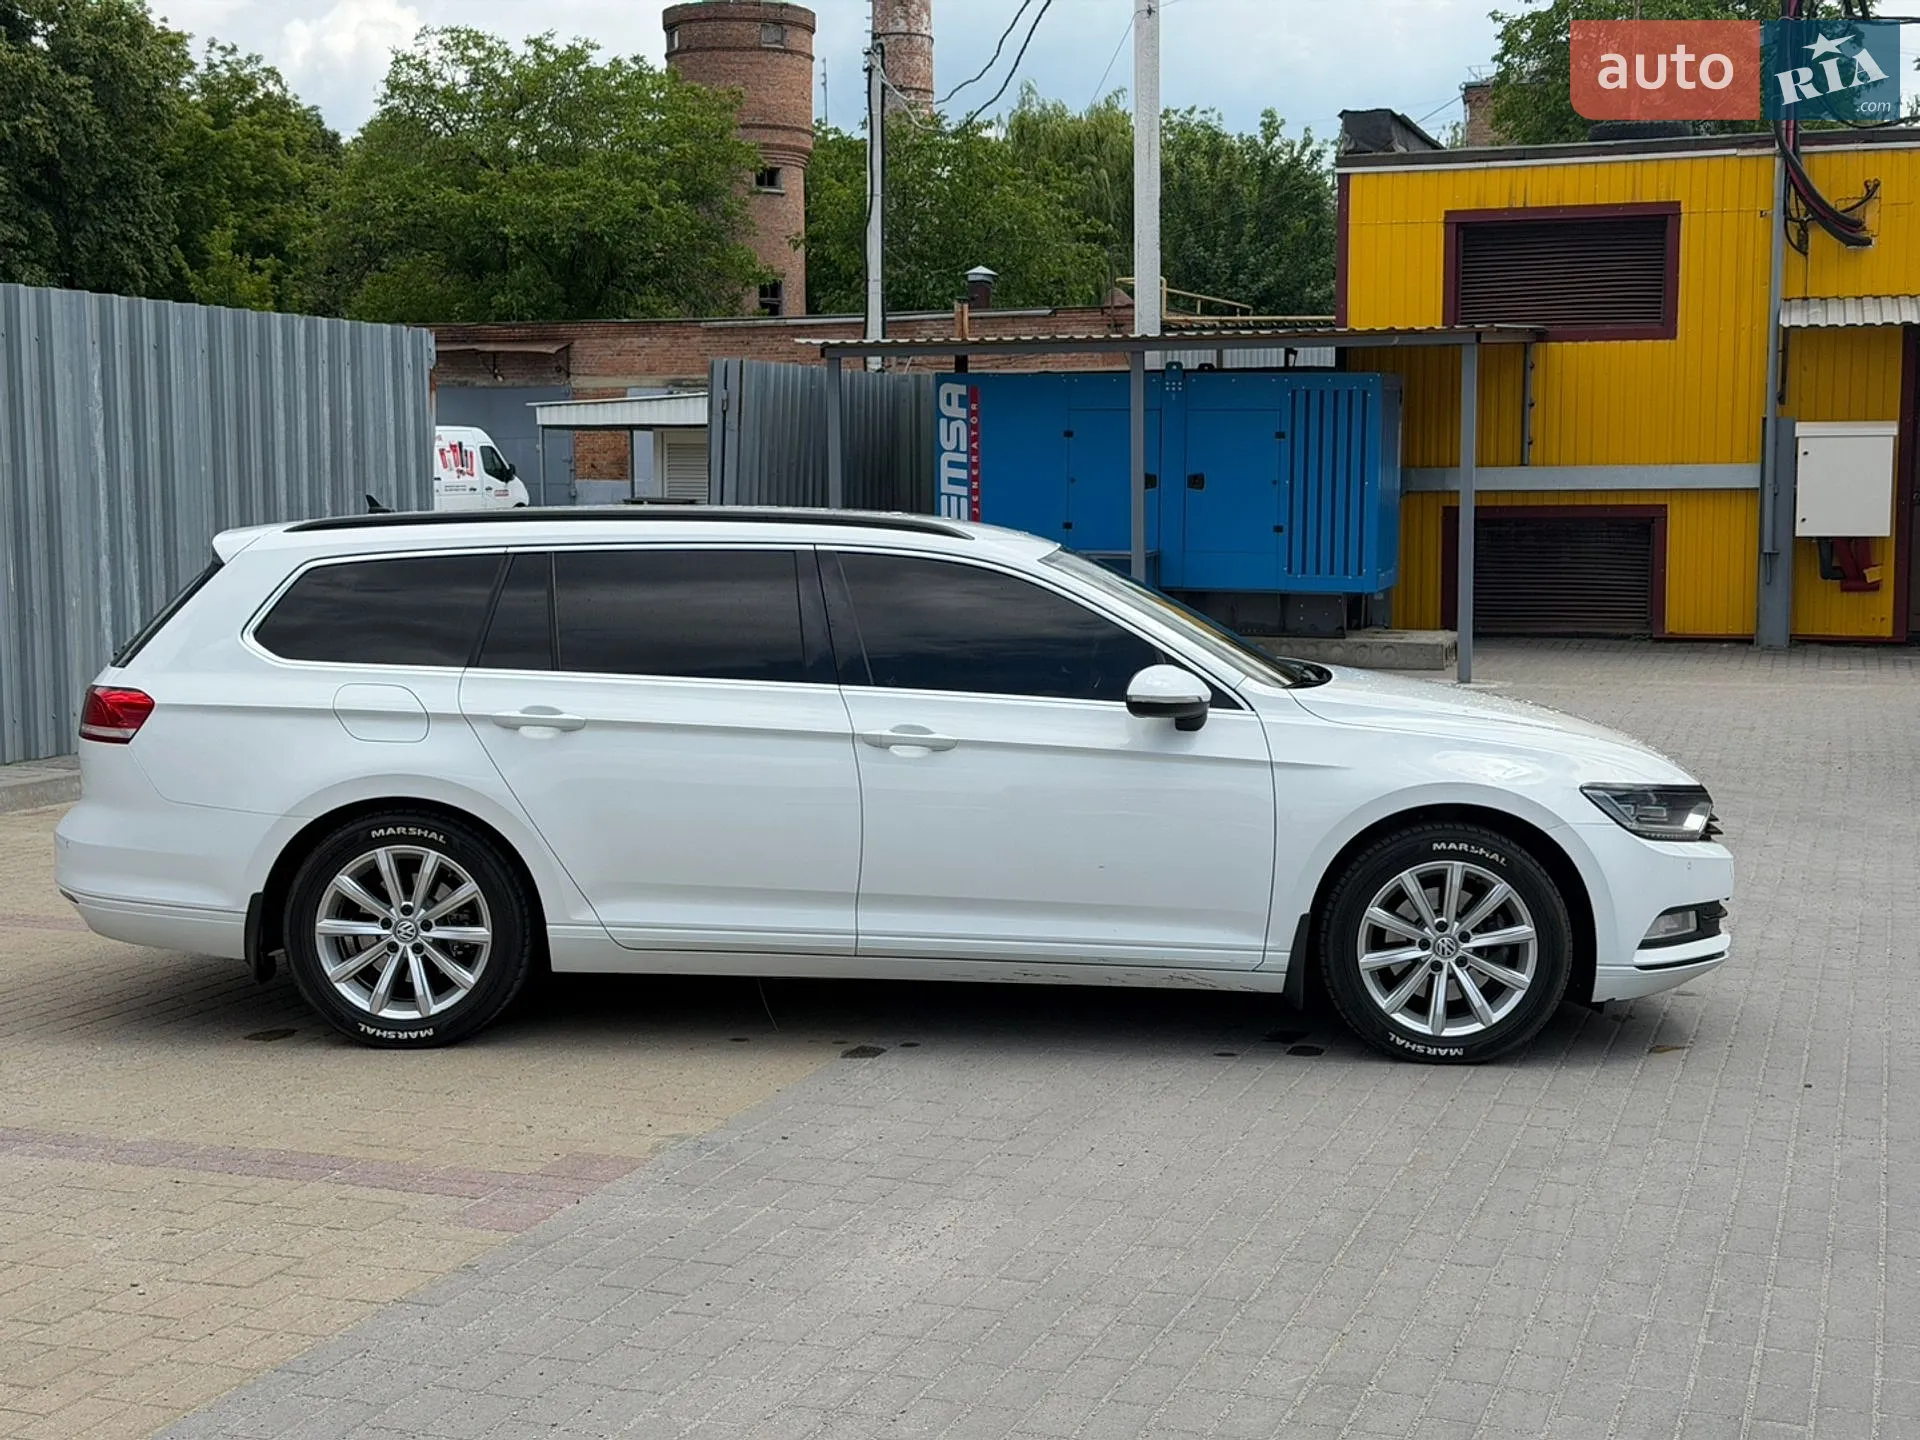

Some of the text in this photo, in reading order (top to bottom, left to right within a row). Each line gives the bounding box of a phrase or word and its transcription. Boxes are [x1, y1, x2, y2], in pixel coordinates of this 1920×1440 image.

[939, 382, 968, 520] EMSA
[970, 403, 979, 513] JENERATOR
[371, 826, 447, 844] MARSHAL
[1432, 842, 1508, 867] MARSHAL
[357, 1022, 434, 1039] MARSHAL
[1388, 1031, 1463, 1056] MARSHAL
